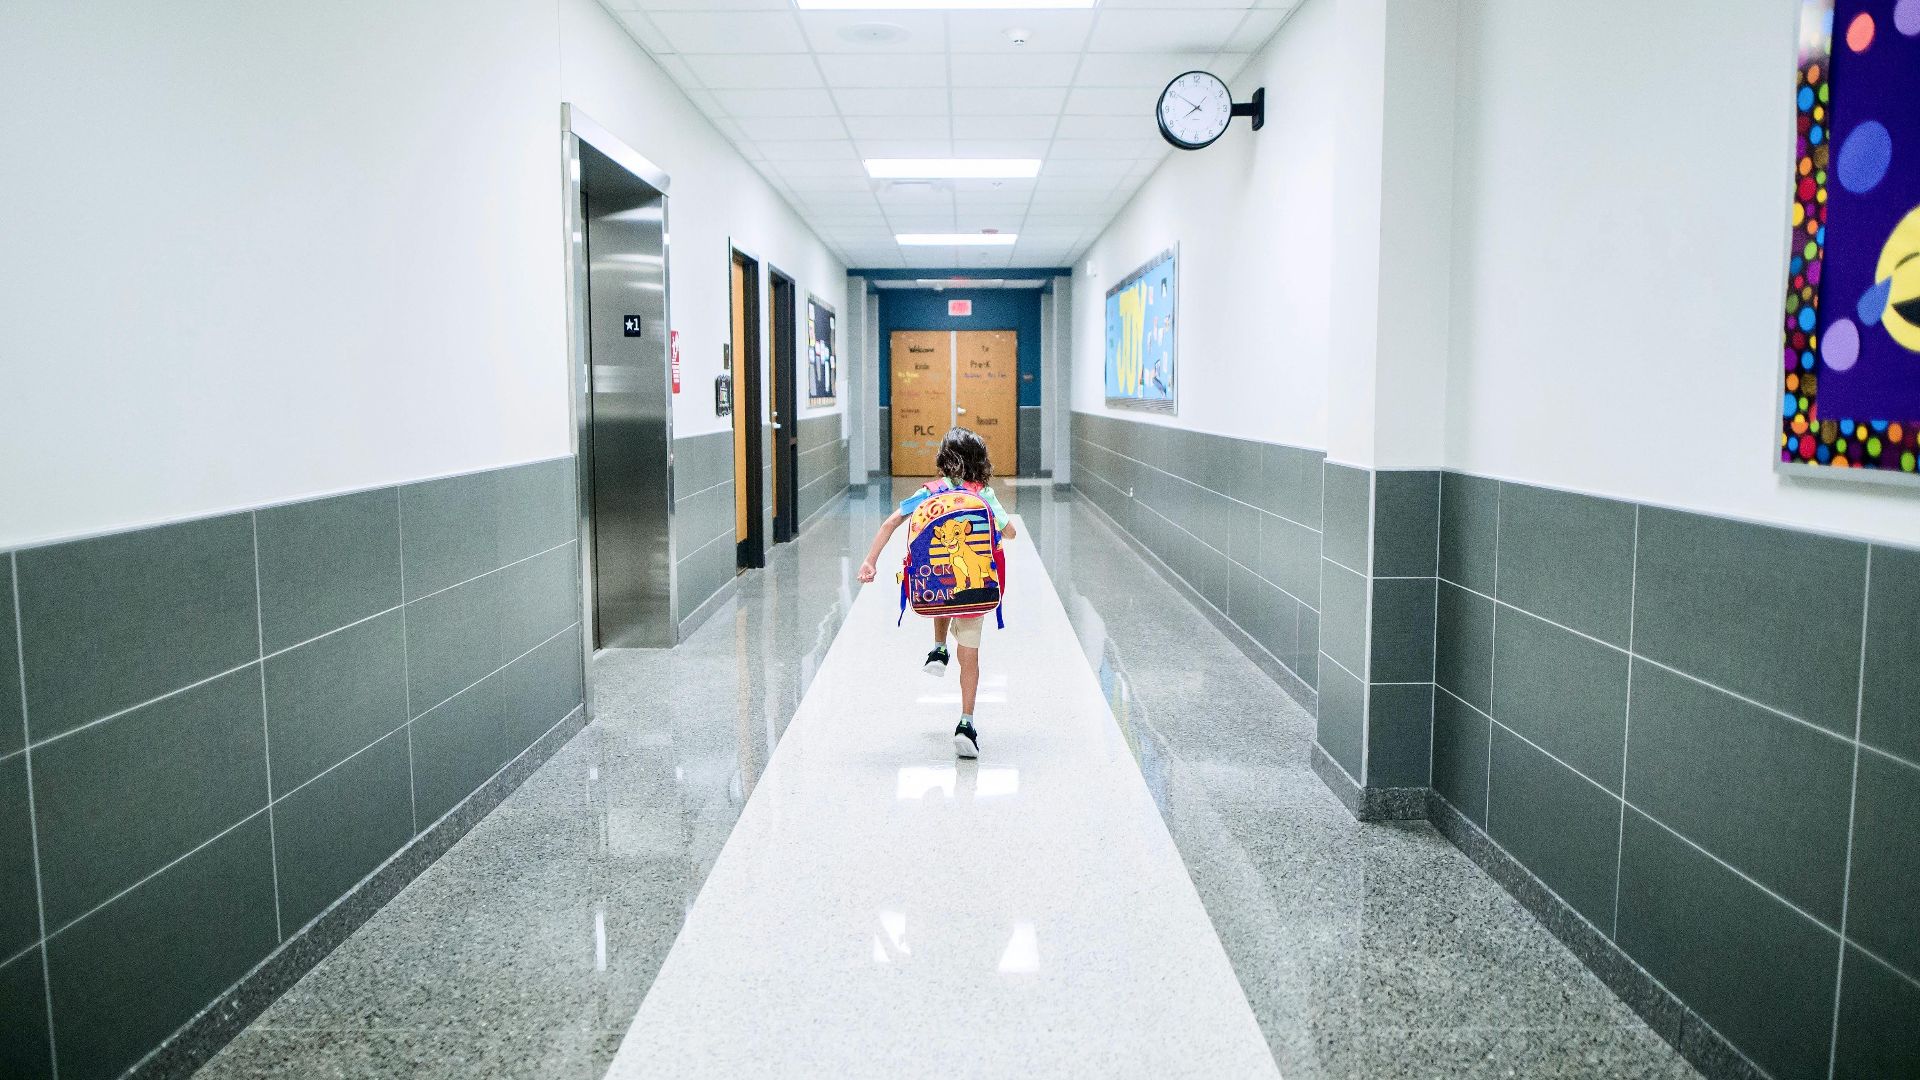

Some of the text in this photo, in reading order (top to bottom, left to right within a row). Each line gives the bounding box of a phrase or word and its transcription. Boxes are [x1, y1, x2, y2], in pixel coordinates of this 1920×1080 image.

[1193, 75, 1201, 84] 12
[1169, 90, 1177, 98] 10
[1218, 90, 1224, 98] 2
[1164, 105, 1170, 113] 9
[1222, 105, 1228, 113] 3
[1169, 120, 1174, 128] 8
[1218, 119, 1224, 127] 4
[1194, 132, 1199, 142] 6
[1208, 129, 1214, 138] 5
[634, 318, 640, 331] 1
[914, 425, 935, 436] PLC
[912, 564, 951, 577] OCK
[912, 588, 954, 602] ROAR
